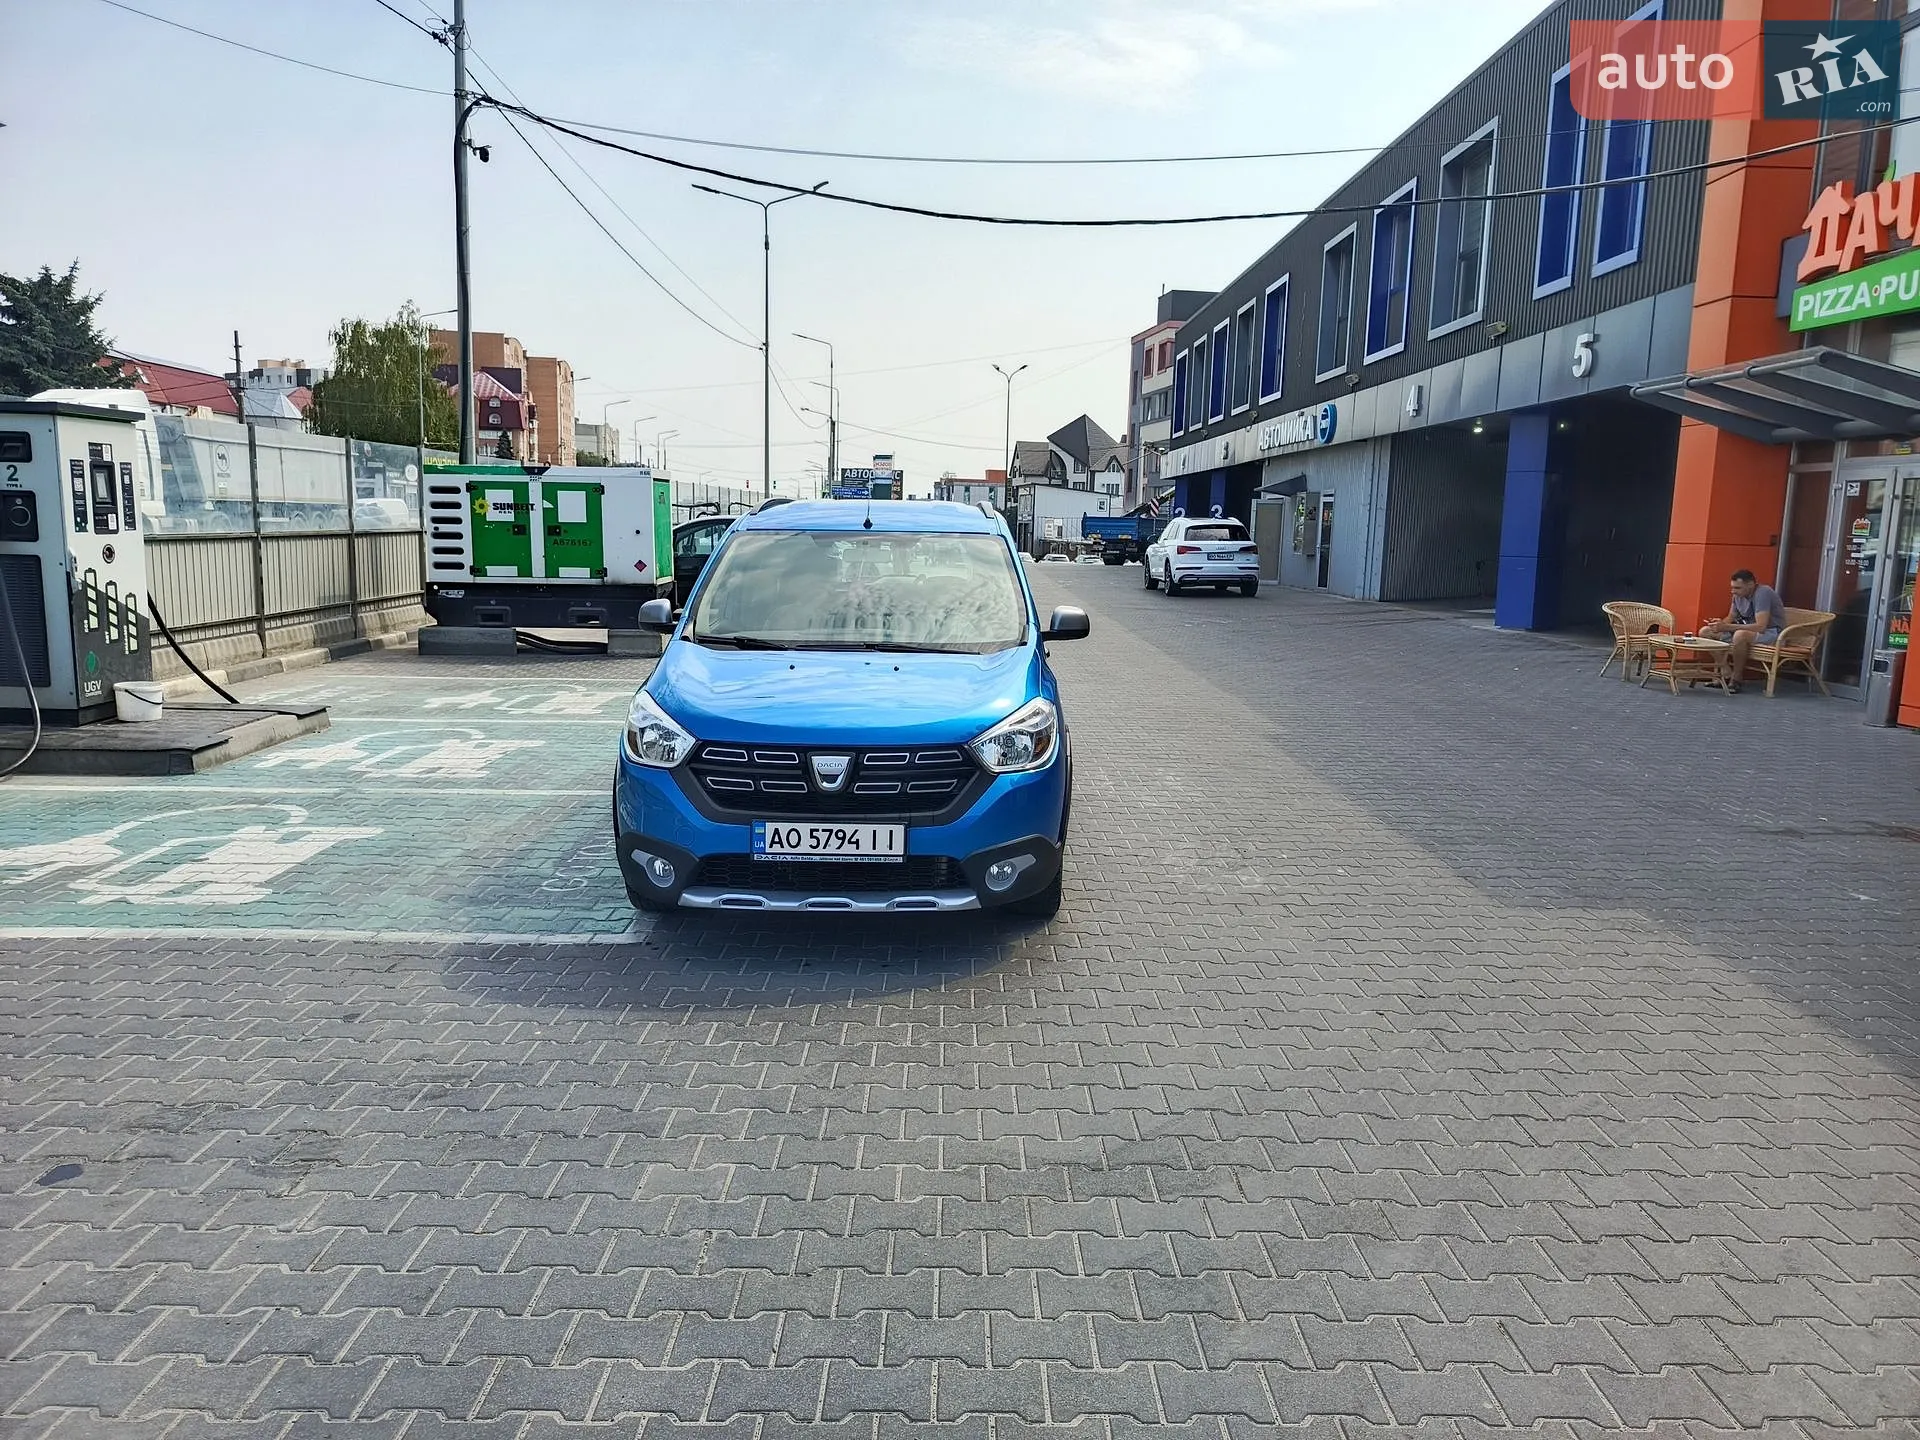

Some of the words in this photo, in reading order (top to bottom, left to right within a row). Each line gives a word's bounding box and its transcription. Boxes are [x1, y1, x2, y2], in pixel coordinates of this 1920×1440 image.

[1796, 172, 1920, 282] ДАЧ
[1797, 281, 1872, 321] PIZZA
[1878, 269, 1920, 305] PU
[1571, 333, 1594, 378] 5
[1405, 384, 1420, 417] 4
[1258, 412, 1316, 450] АВТОМИЙКА
[6, 464, 19, 481] 2
[492, 503, 535, 511] SUNBELT
[84, 680, 101, 692] UGV
[769, 828, 801, 849] AO
[809, 828, 860, 850] 5794
[872, 829, 893, 851] II
